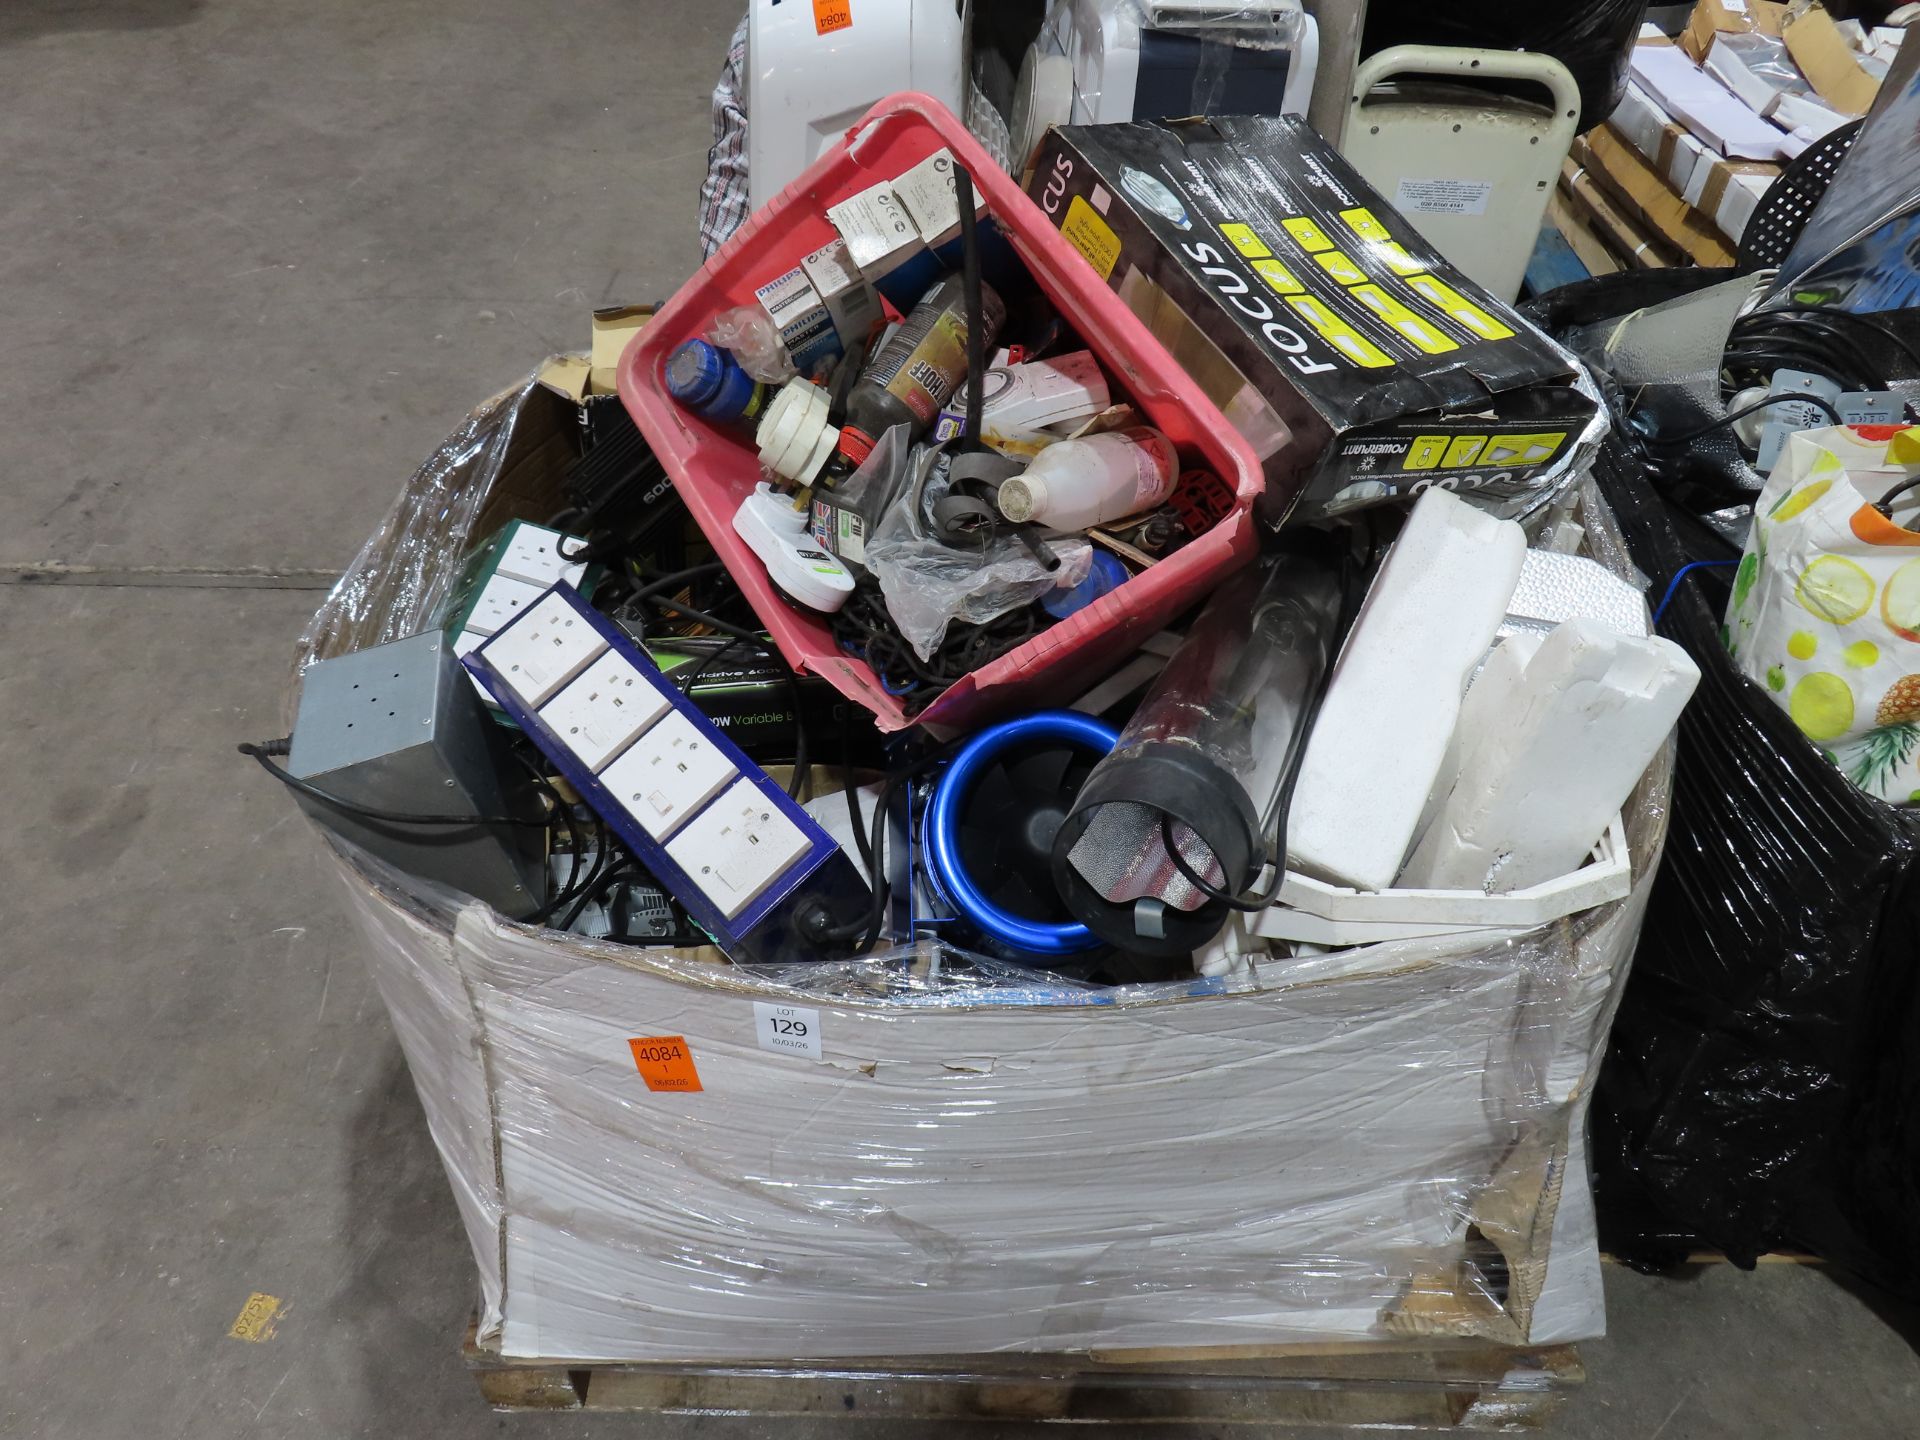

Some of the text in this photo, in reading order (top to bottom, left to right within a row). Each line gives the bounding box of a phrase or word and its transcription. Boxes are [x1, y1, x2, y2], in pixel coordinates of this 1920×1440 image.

[820, 12, 847, 27] 4084
[1040, 152, 1074, 220] CUS
[1300, 153, 1353, 206] POWERPLANT
[1065, 224, 1080, 242] round
[757, 267, 801, 297] PHILIPS
[1180, 242, 1338, 375] FOCUS
[781, 307, 825, 337] PHILIPS
[1341, 443, 1407, 456] POWERPLANT
[733, 711, 784, 726] Variable
[776, 1008, 796, 1016] LOT
[770, 1018, 807, 1036] 129
[772, 1037, 808, 1050] 10/03/26
[640, 1046, 682, 1062] 4084
[663, 1064, 668, 1072] 1
[654, 1078, 689, 1087] 06/02/26
